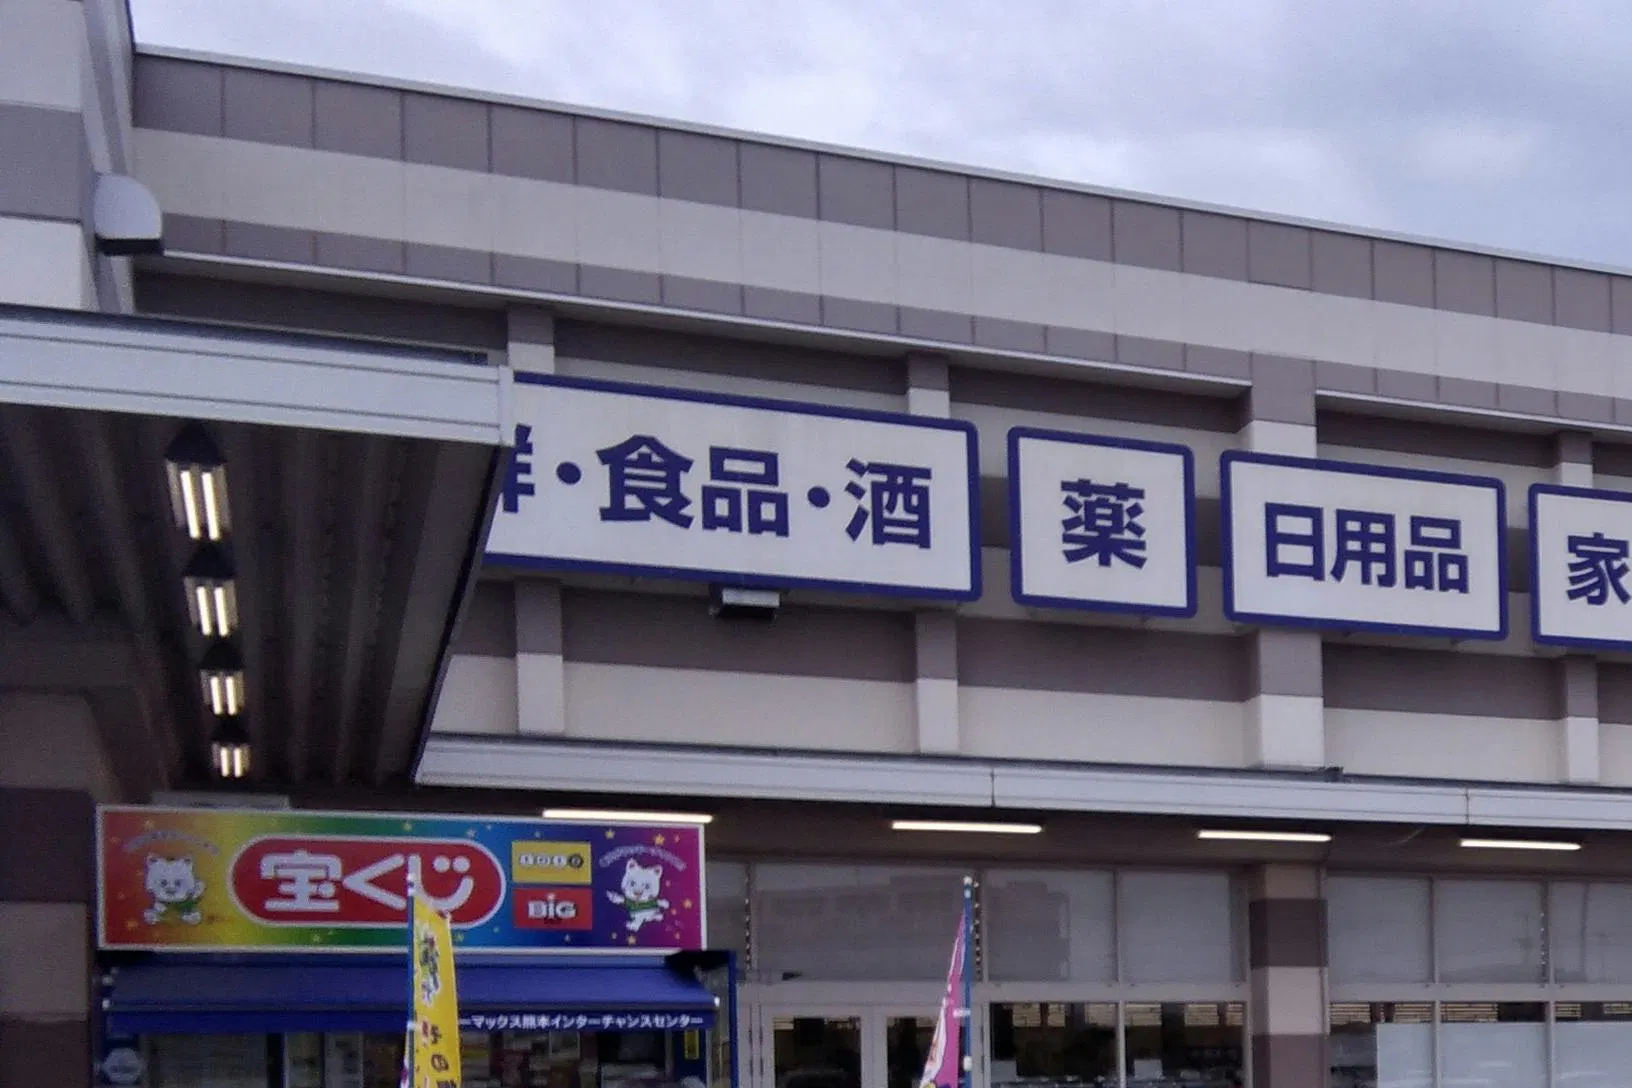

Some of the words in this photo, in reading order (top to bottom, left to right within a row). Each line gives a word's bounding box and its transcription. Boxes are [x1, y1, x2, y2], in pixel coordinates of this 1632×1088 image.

[1060, 478, 1148, 570] 薬
[1264, 501, 1470, 594] 日用品
[261, 849, 475, 913] 宝くじ
